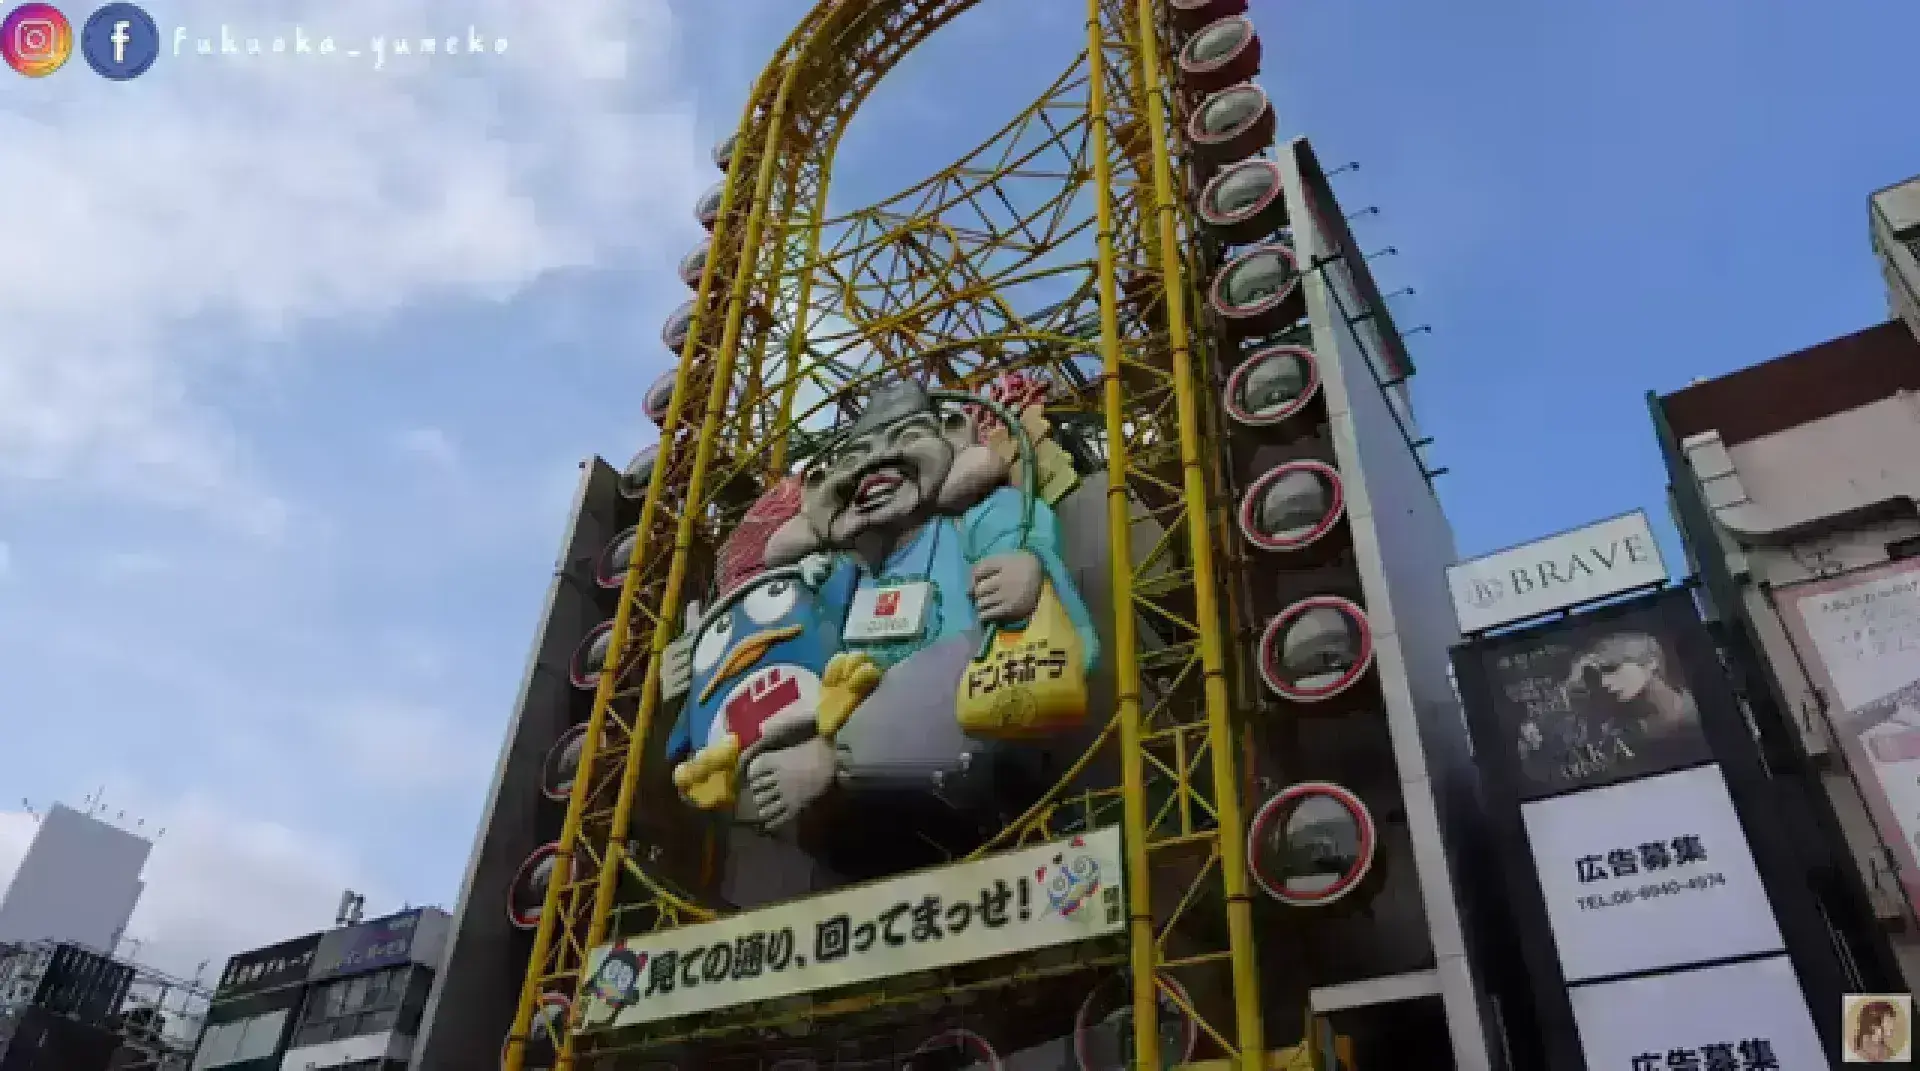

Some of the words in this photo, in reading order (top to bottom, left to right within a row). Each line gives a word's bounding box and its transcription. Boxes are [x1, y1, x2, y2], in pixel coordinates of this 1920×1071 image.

[1510, 534, 1648, 595] BRAVE
[1575, 834, 1708, 883] 広告募集
